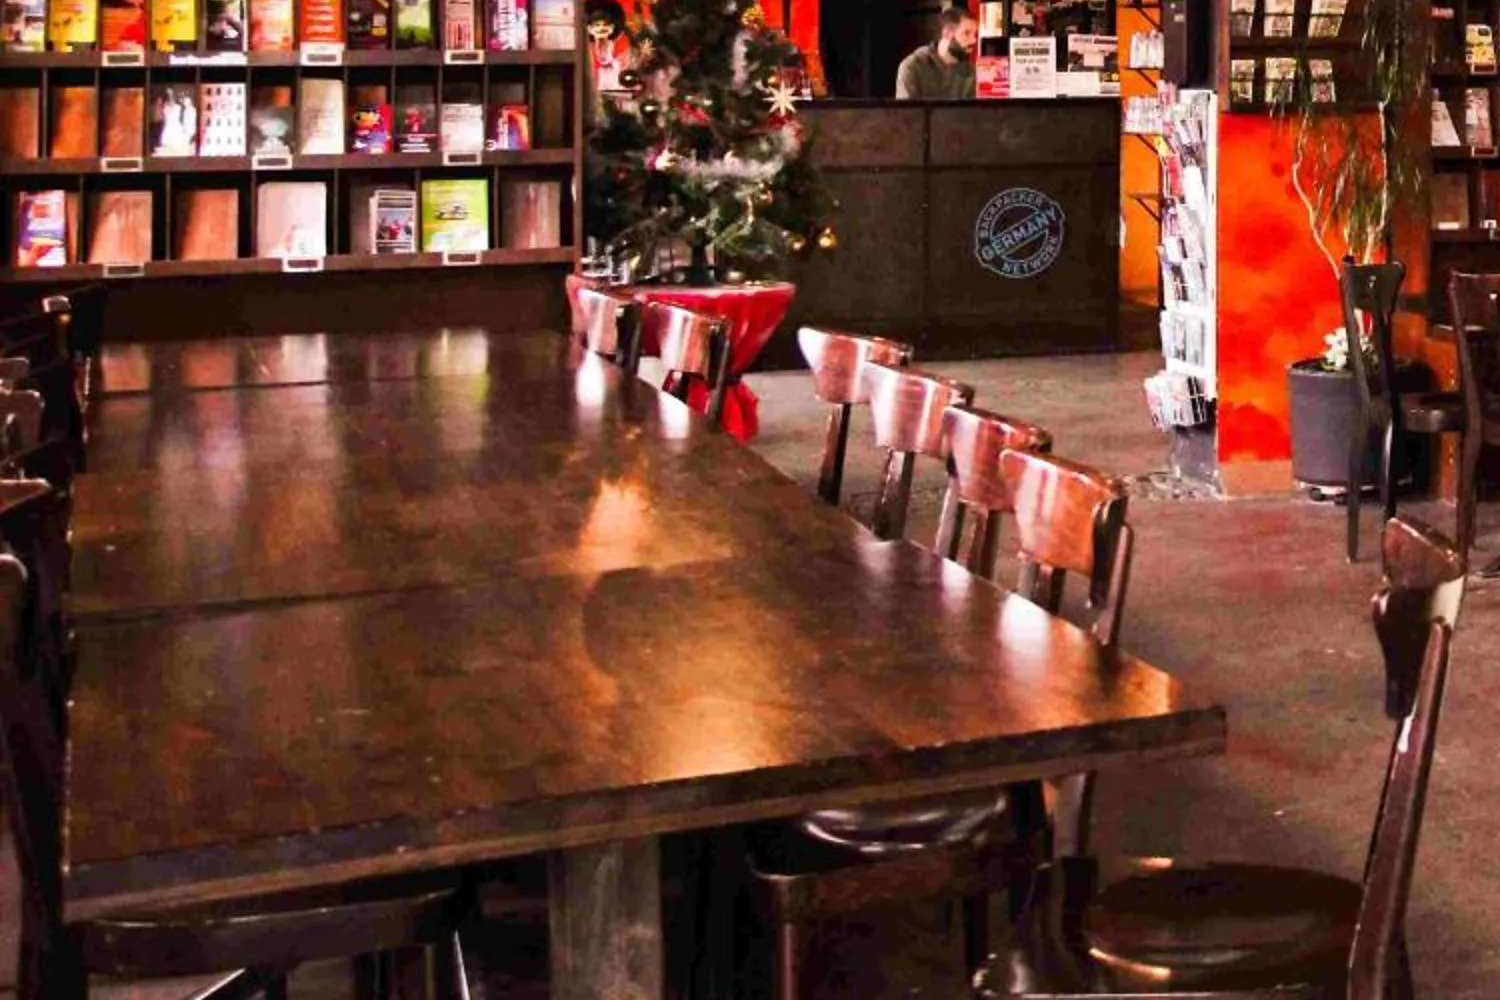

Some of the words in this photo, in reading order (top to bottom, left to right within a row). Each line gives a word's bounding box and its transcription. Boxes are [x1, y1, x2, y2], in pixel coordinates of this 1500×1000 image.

[979, 191, 1042, 239] BACKPACKER
[981, 207, 1057, 260] GERMANY
[1001, 236, 1058, 273] NETWORK
